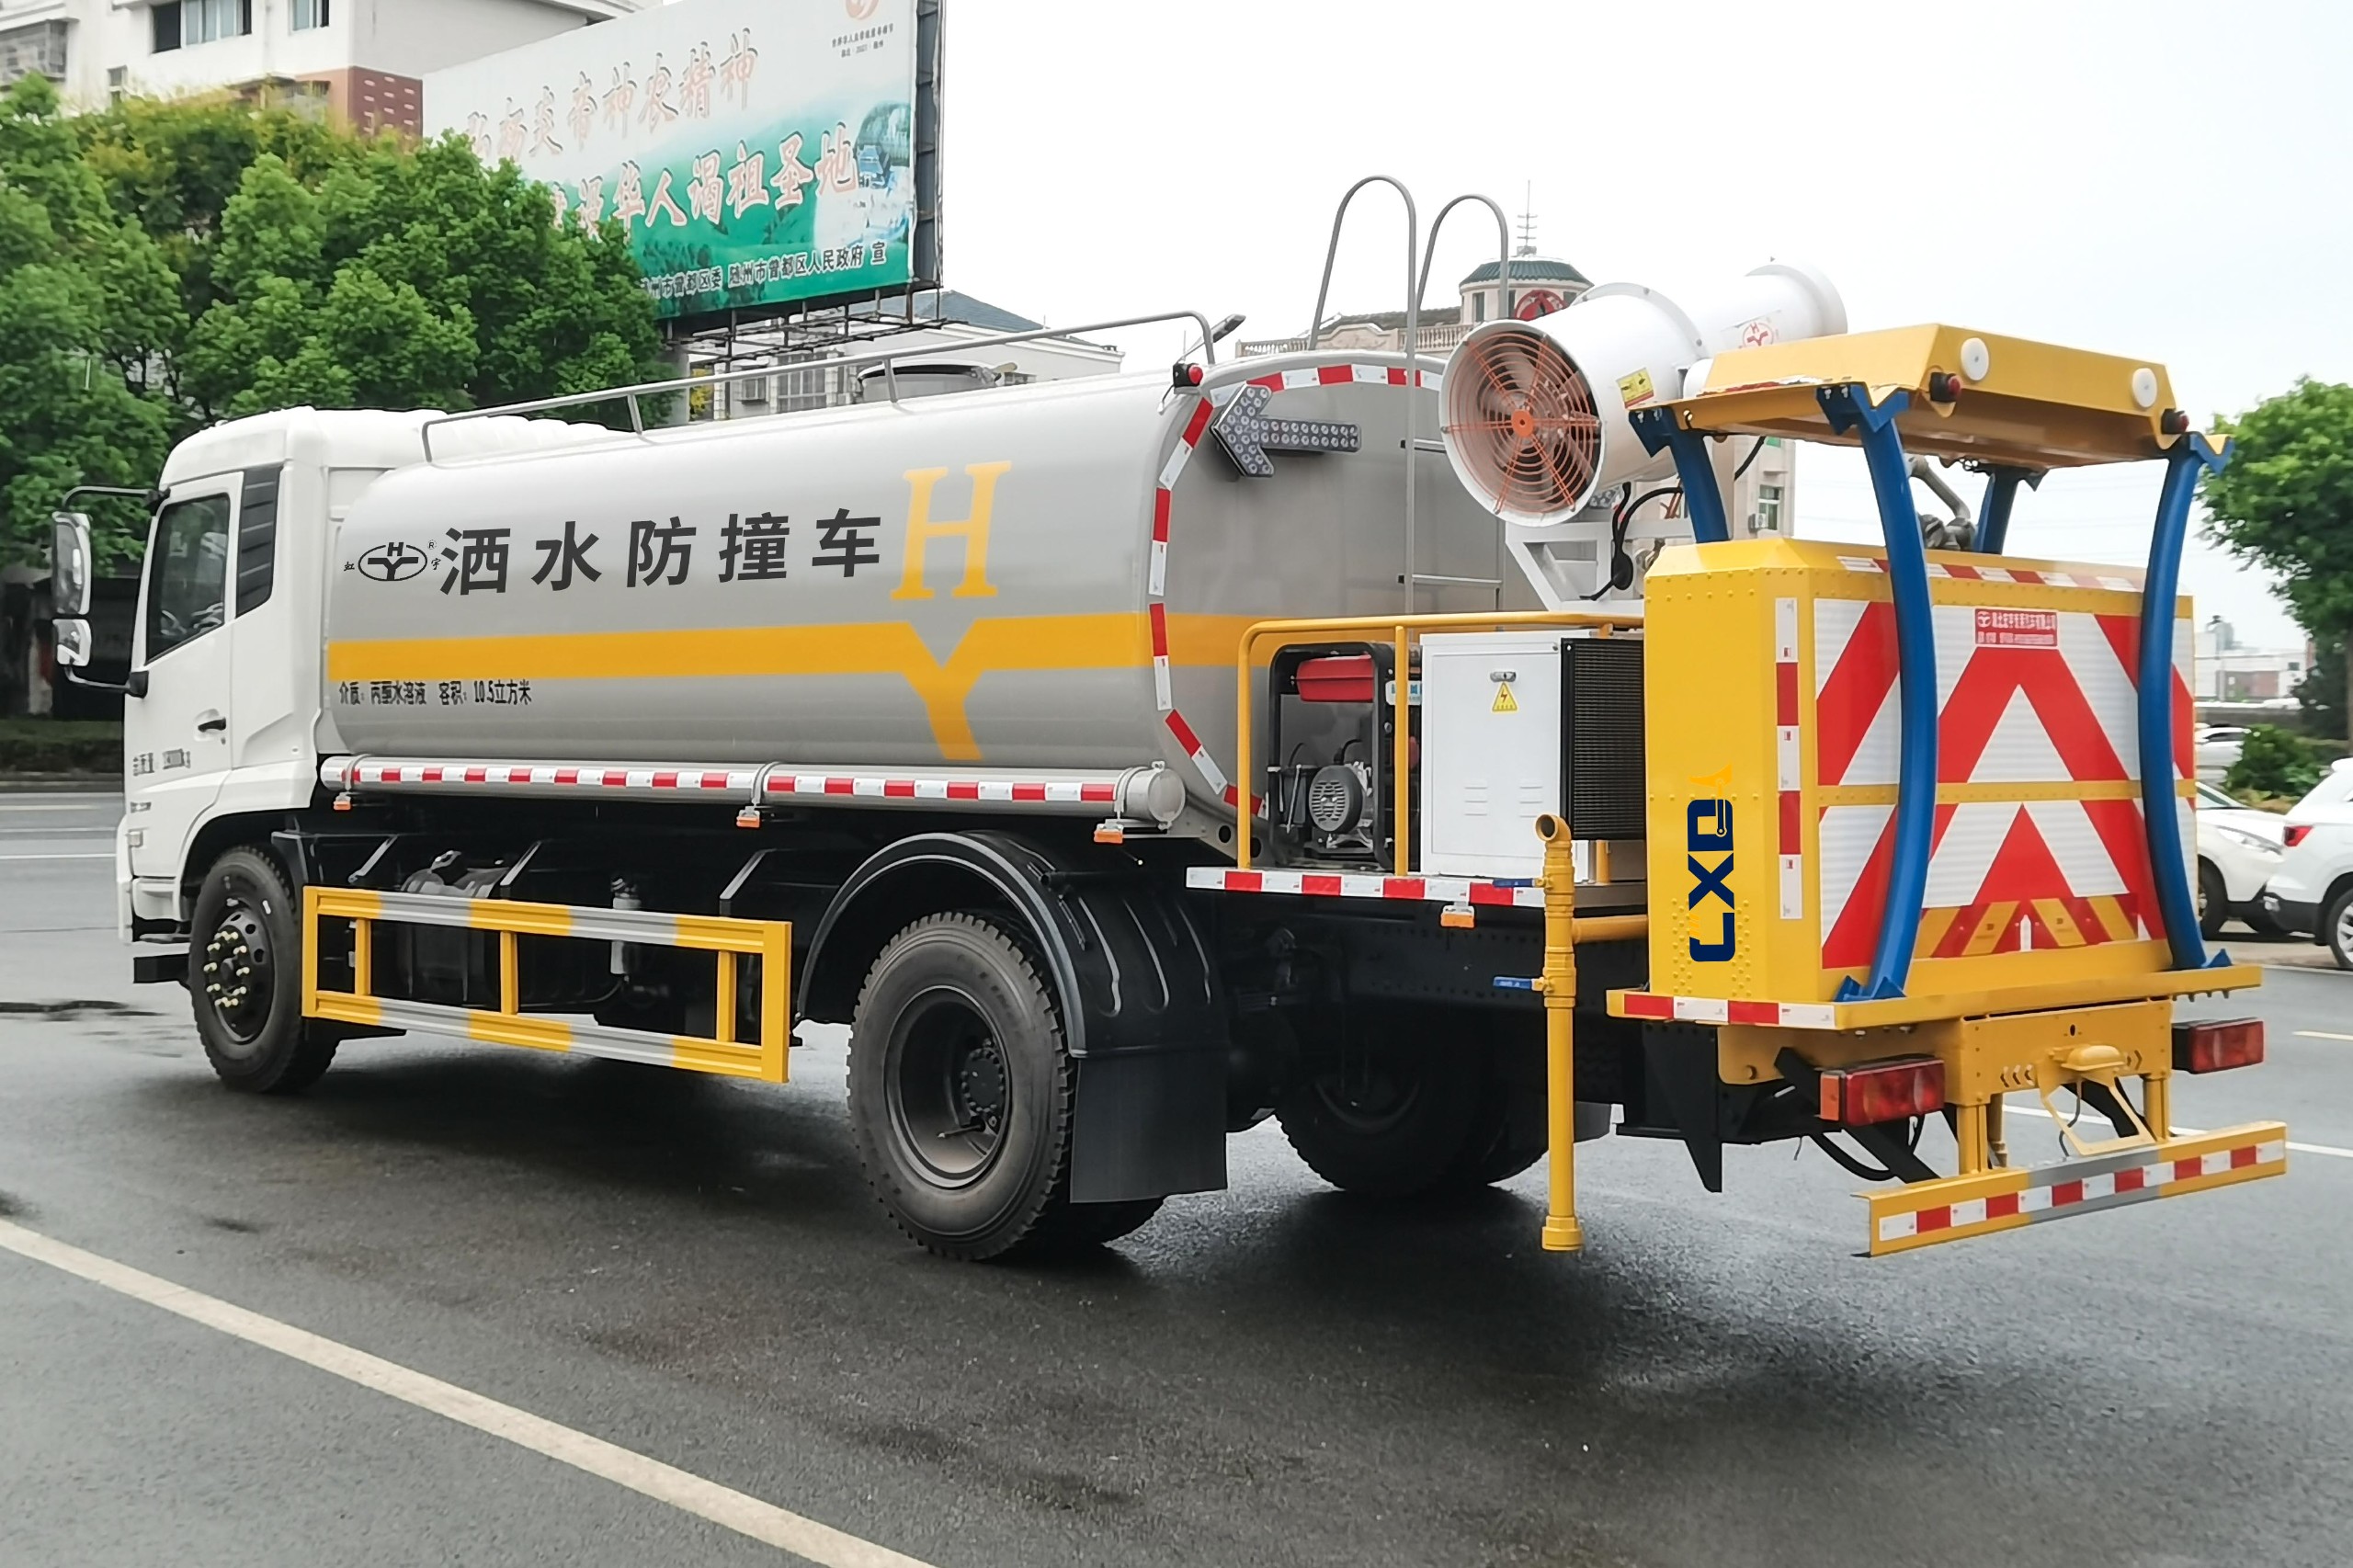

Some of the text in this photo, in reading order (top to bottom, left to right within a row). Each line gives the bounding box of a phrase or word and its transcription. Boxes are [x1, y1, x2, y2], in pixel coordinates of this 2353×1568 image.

[727, 243, 865, 289] 随州市曾都区人民政府
[870, 239, 887, 265] 宣
[439, 507, 881, 597] 洒水防撞车
